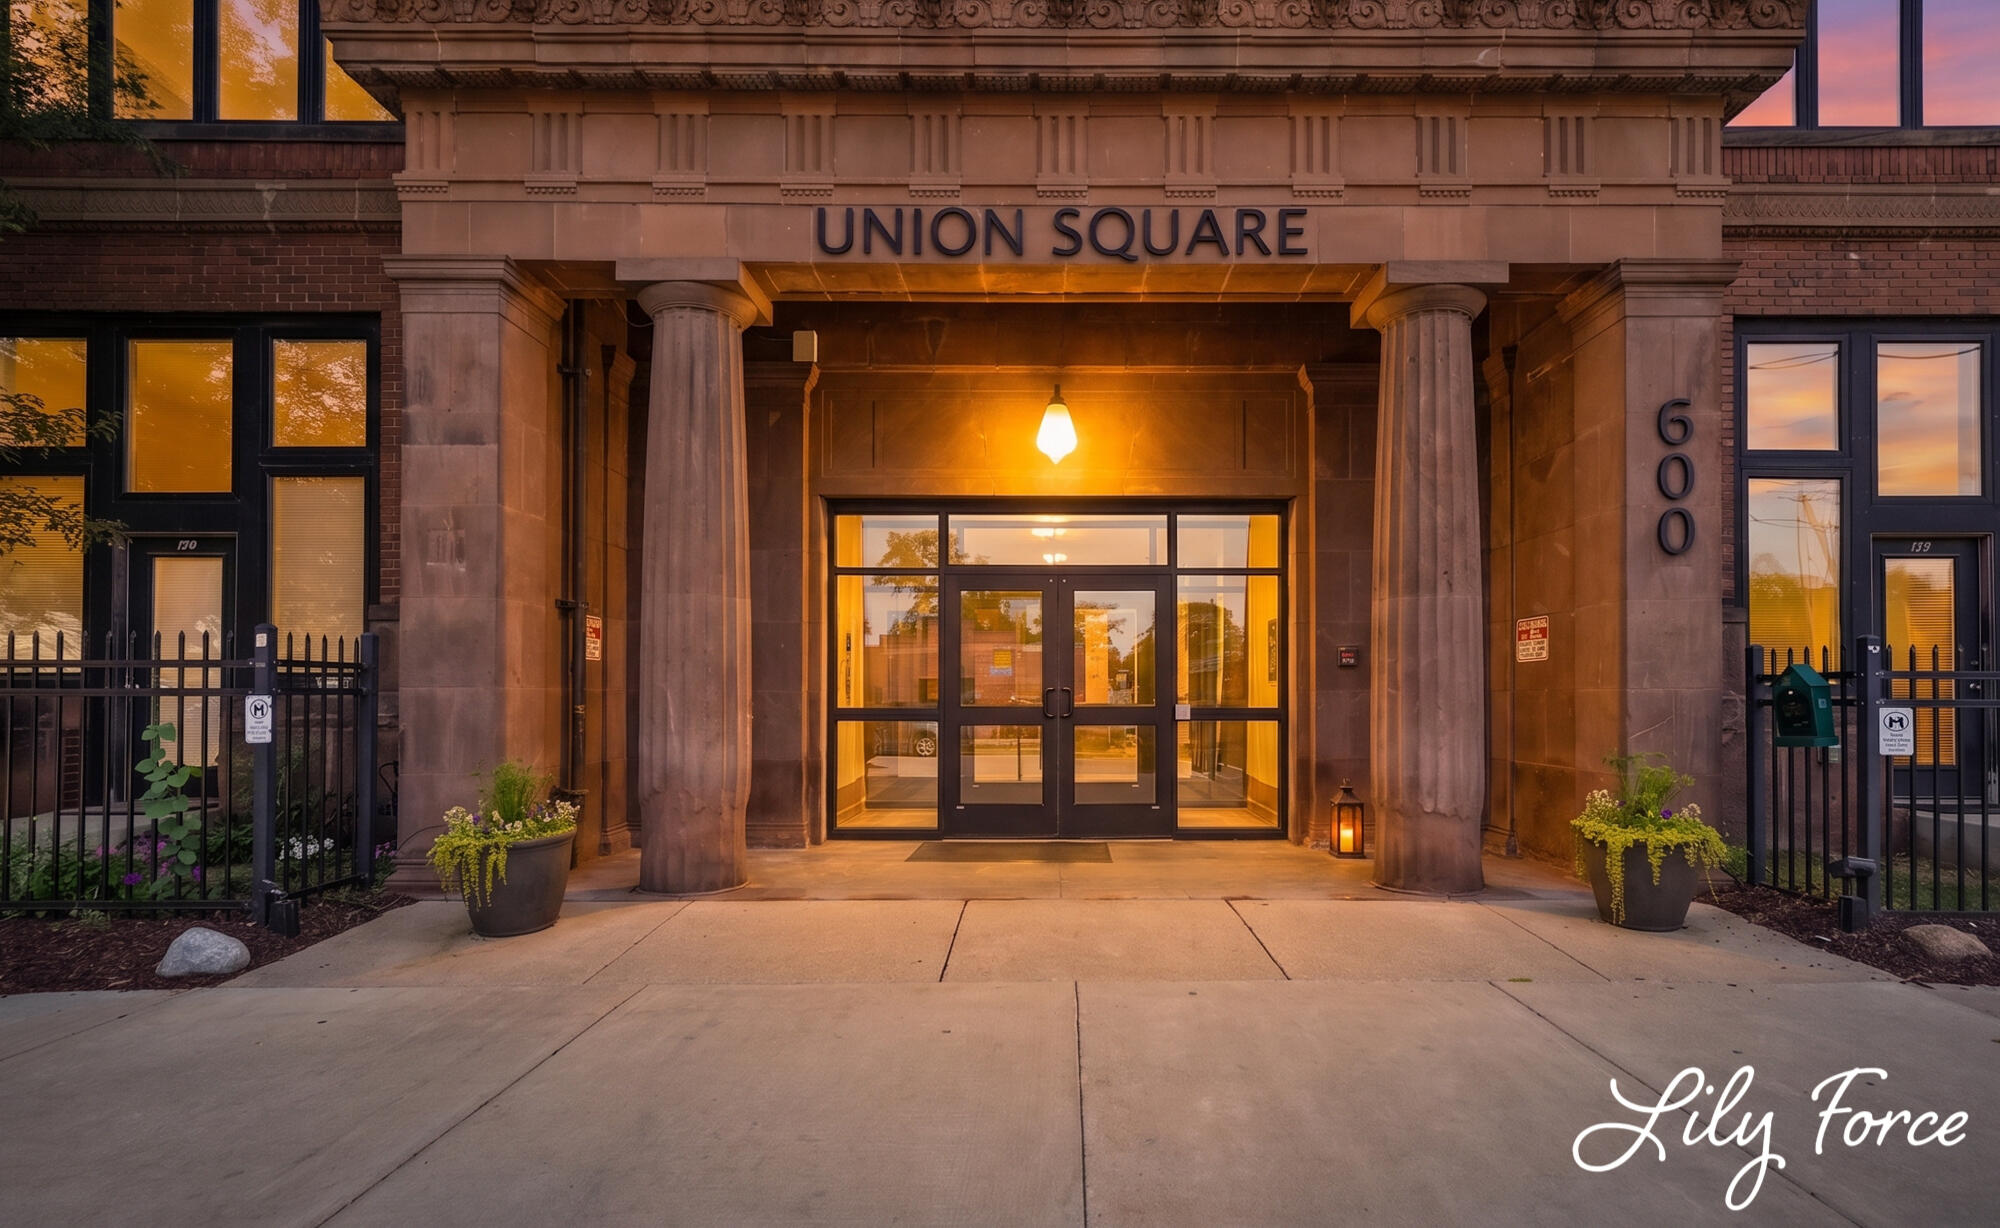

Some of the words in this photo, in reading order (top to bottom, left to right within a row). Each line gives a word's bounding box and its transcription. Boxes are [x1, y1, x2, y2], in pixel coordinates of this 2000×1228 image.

[816, 206, 1023, 259] UNION
[1052, 206, 1309, 263] SQUARE
[1655, 398, 1696, 559] 600
